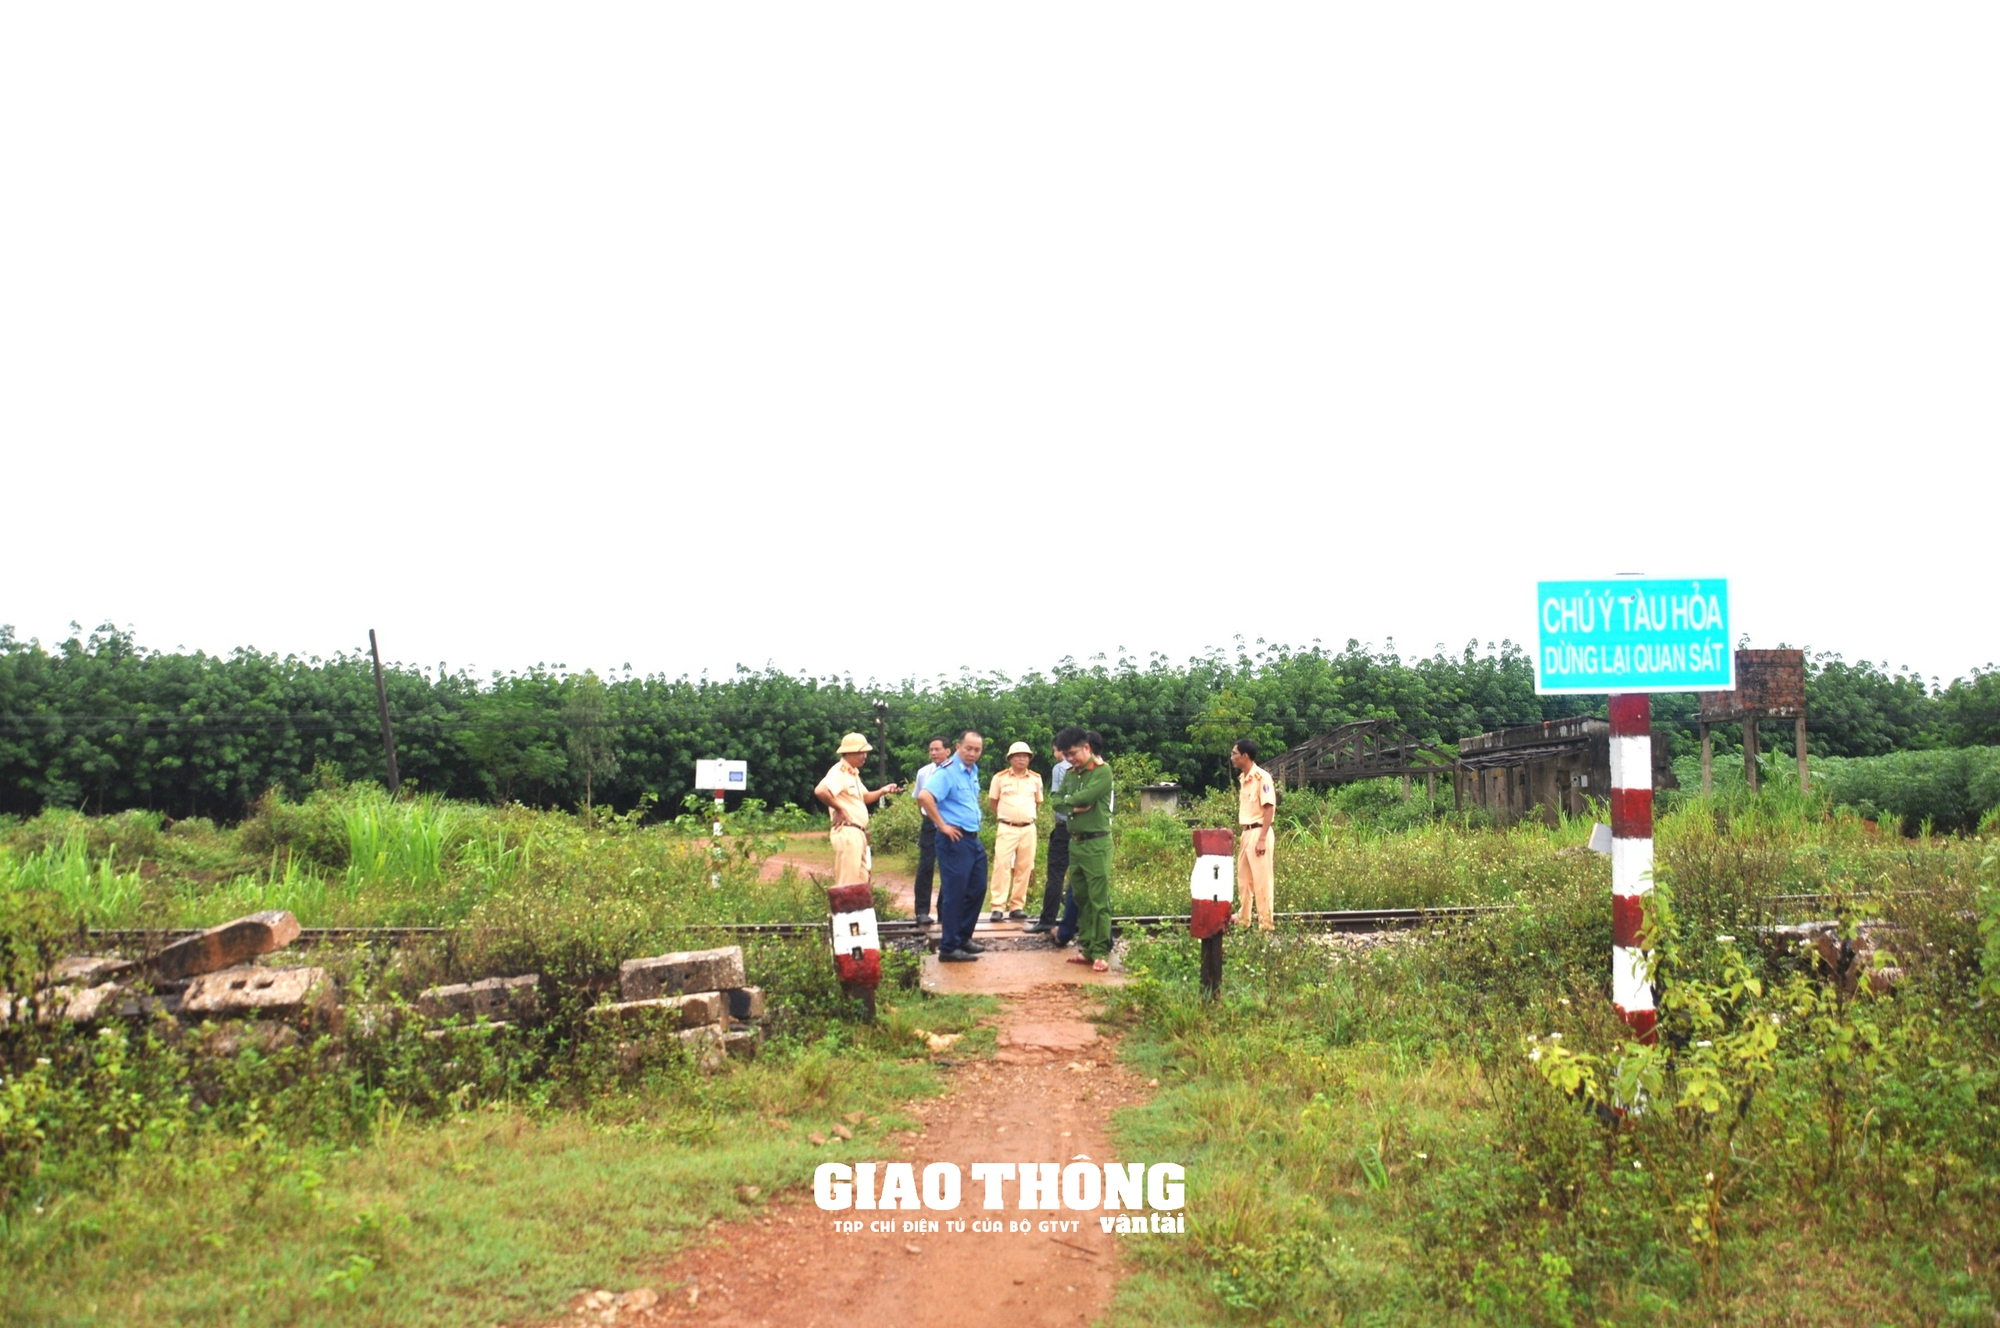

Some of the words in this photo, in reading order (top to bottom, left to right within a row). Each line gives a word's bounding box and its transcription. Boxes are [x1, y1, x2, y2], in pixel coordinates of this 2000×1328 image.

[1543, 589, 1595, 634] CHÚ
[1597, 589, 1614, 632] Ý
[1618, 587, 1667, 632] TÀU
[1671, 581, 1724, 631] HỎA
[1545, 640, 1598, 675] DỪNG
[1601, 644, 1630, 676] LẠI
[1633, 643, 1687, 673] QUAN
[1689, 636, 1724, 672] SÁT
